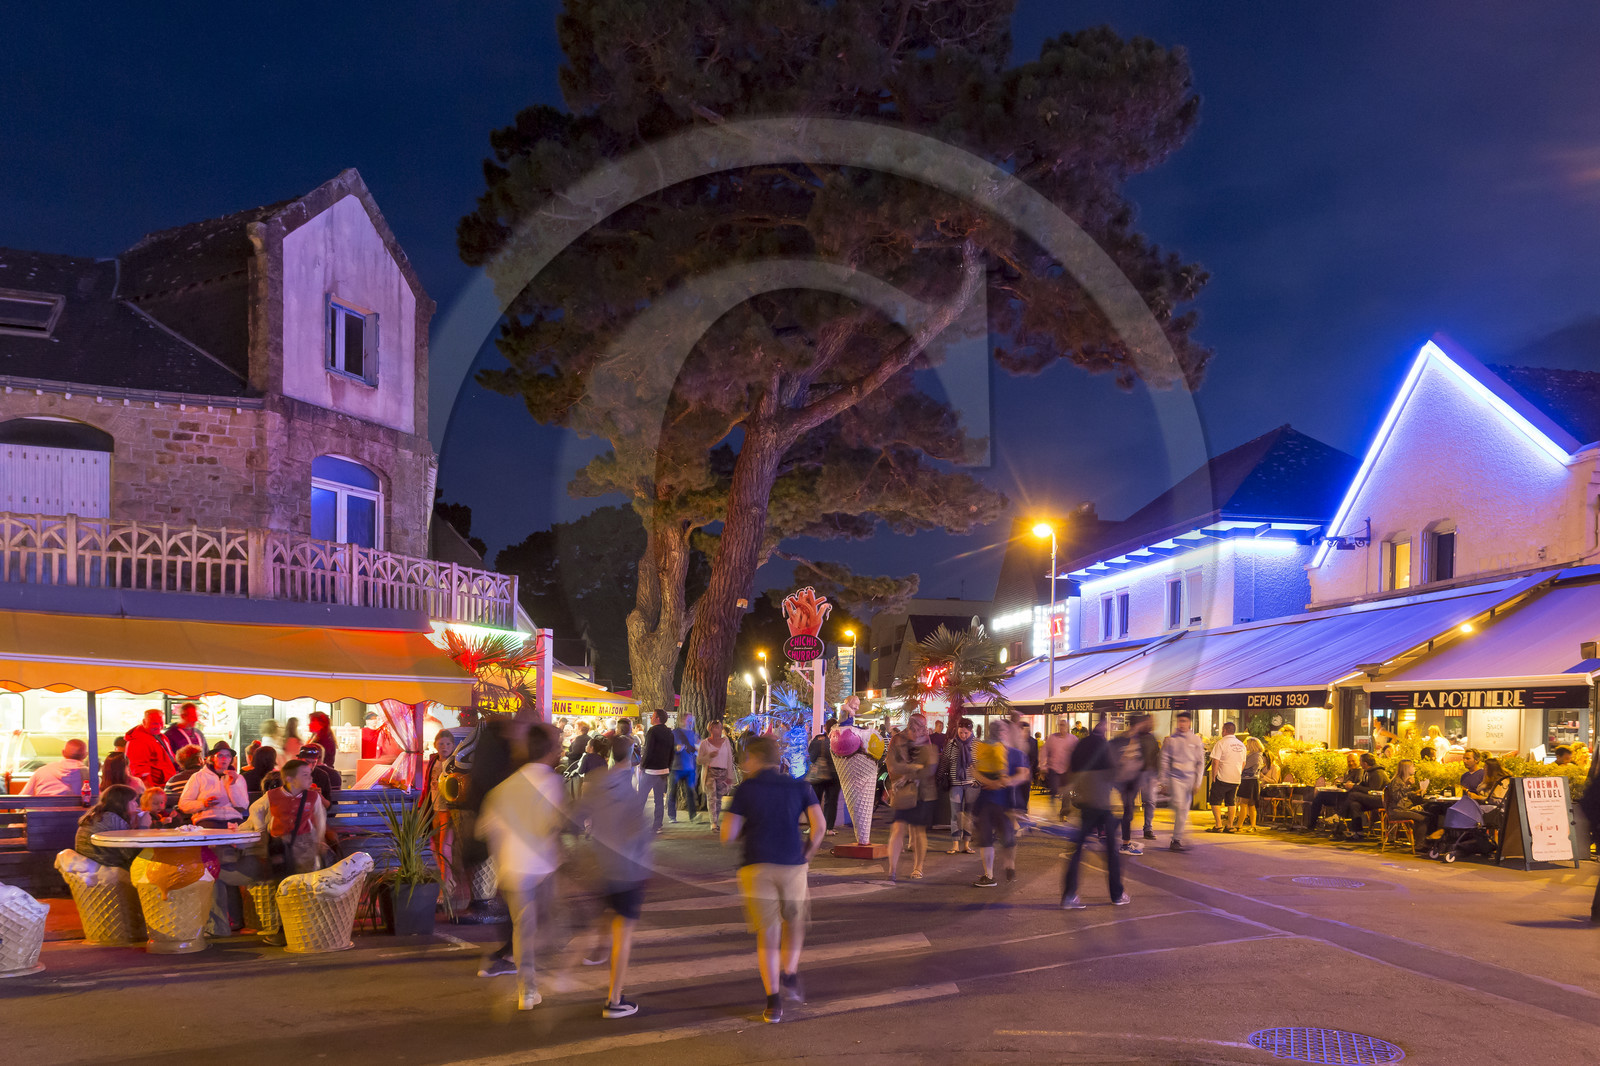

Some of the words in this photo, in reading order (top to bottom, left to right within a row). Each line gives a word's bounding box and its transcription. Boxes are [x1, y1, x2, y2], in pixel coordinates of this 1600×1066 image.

[789, 636, 817, 647] CHICHIS
[787, 649, 820, 660] CHURROS
[1247, 694, 1282, 707] DEPUIS
[1286, 693, 1310, 706] 1930
[1413, 691, 1436, 708] LA
[1438, 689, 1526, 708] POTINIERE
[1066, 702, 1095, 712] BRASSERIE
[1125, 699, 1136, 711] LA
[1527, 780, 1559, 789] CINEMA
[1527, 789, 1562, 799] VIRTUEL
